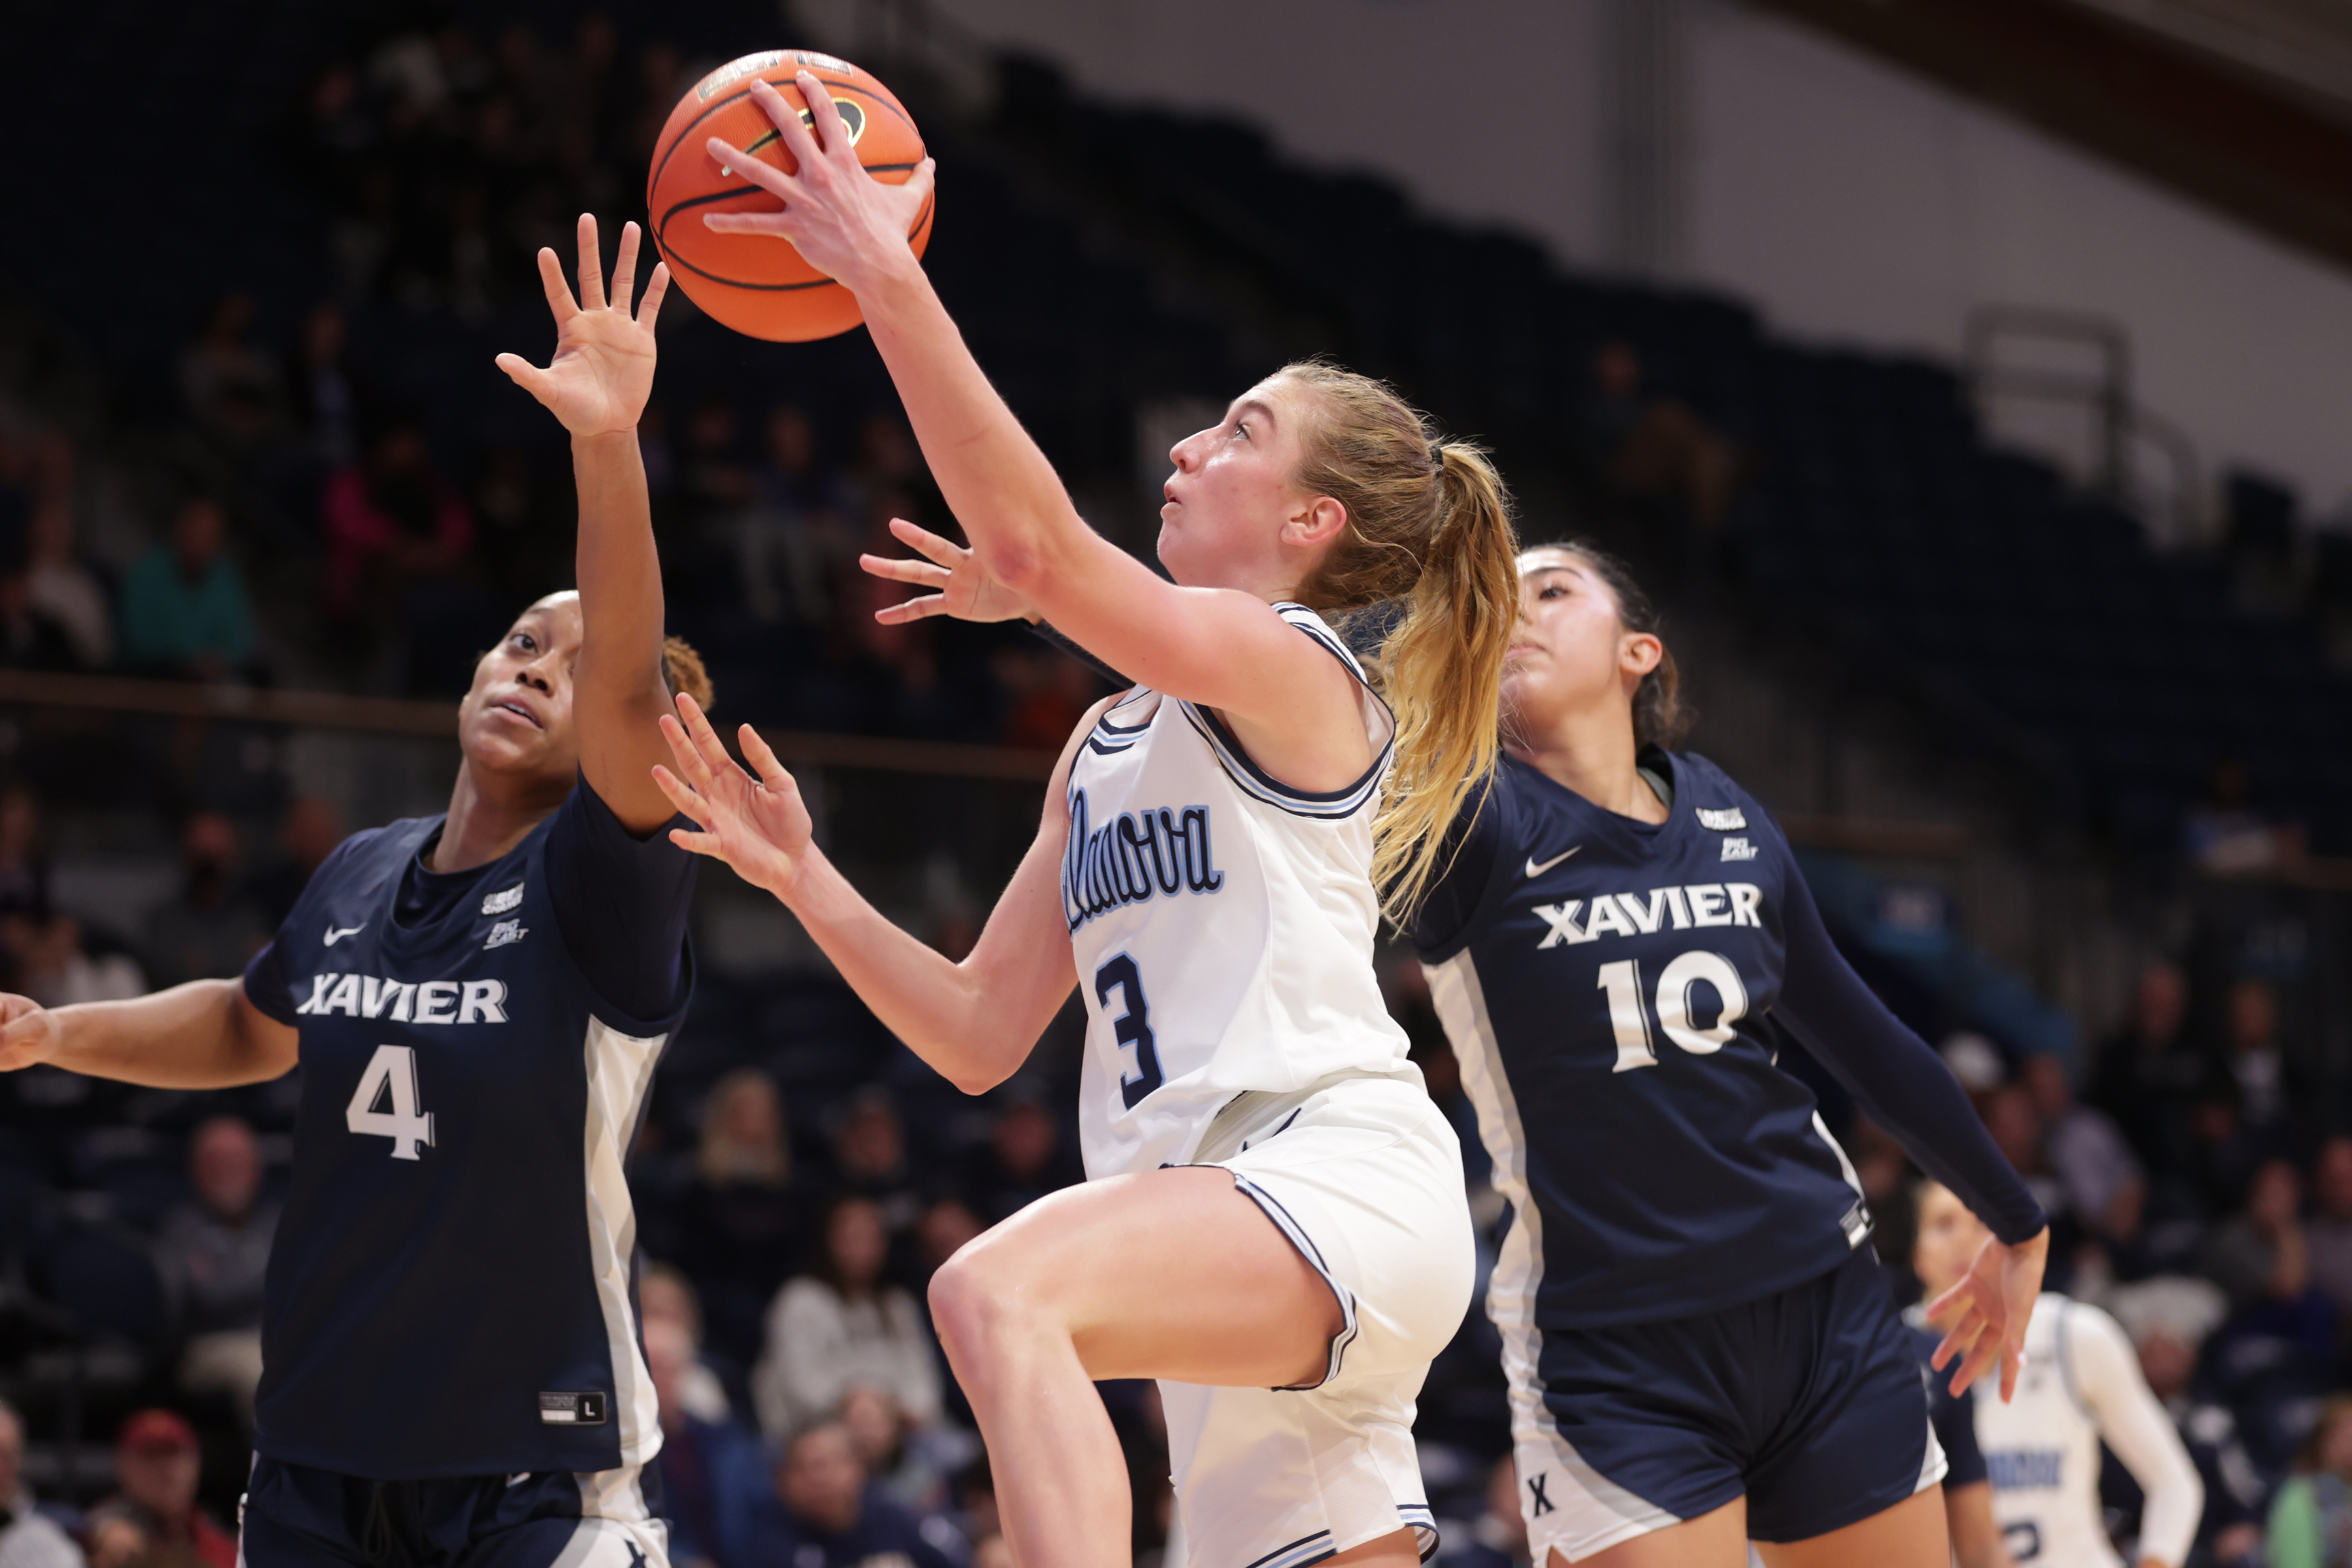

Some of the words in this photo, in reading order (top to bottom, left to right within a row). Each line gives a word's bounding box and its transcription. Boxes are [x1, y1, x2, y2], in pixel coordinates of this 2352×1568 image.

[1721, 846, 1759, 860] EAST
[1531, 883, 1763, 949] XAVIER
[297, 973, 510, 1024] XAVIER
[1597, 950, 1748, 1073] 10
[1095, 951, 1166, 1111] 3
[346, 1045, 435, 1160] 4
[585, 1401, 596, 1416] L
[1527, 1471, 1558, 1518] X
